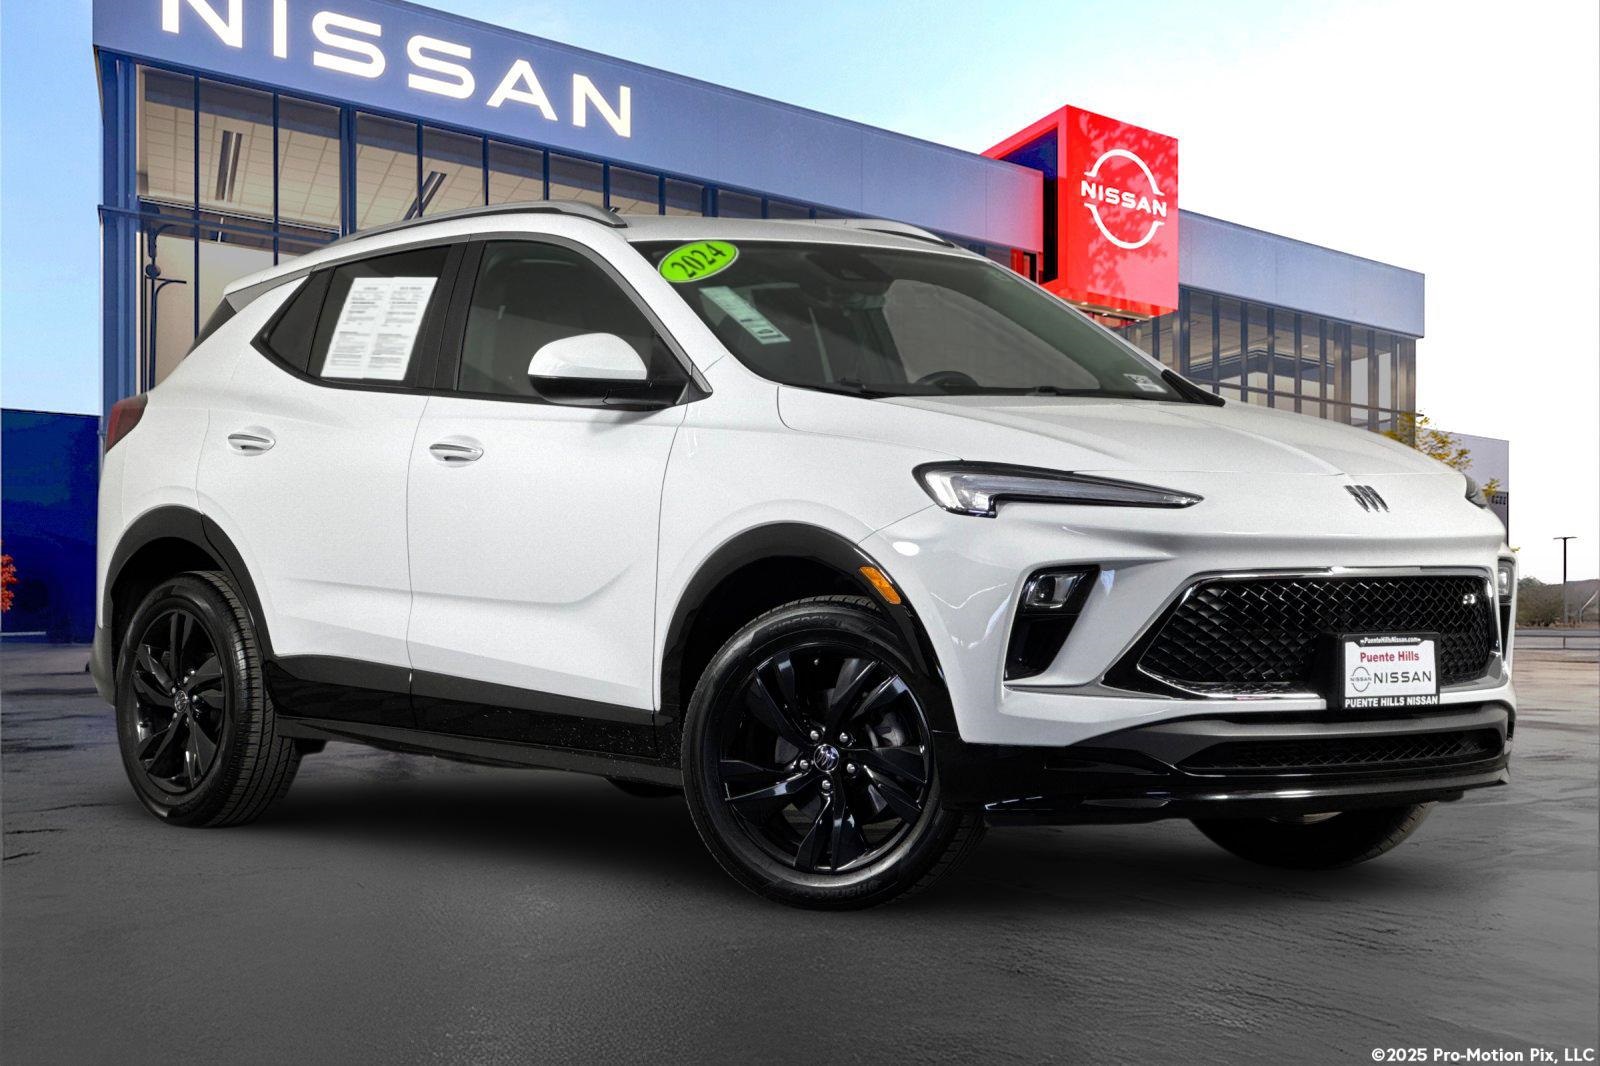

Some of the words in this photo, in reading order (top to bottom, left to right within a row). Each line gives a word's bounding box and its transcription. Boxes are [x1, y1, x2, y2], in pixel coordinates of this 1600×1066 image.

[160, 0, 632, 138] NISSAN
[1080, 179, 1168, 218] NISSAN
[671, 242, 727, 278] 2024
[1360, 652, 1395, 662] Puente
[1398, 651, 1420, 661] Hills
[1373, 671, 1432, 684] NISSAN
[1345, 698, 1379, 708] PUENTE
[1380, 697, 1405, 707] HILLS
[1406, 696, 1438, 706] NISSAN
